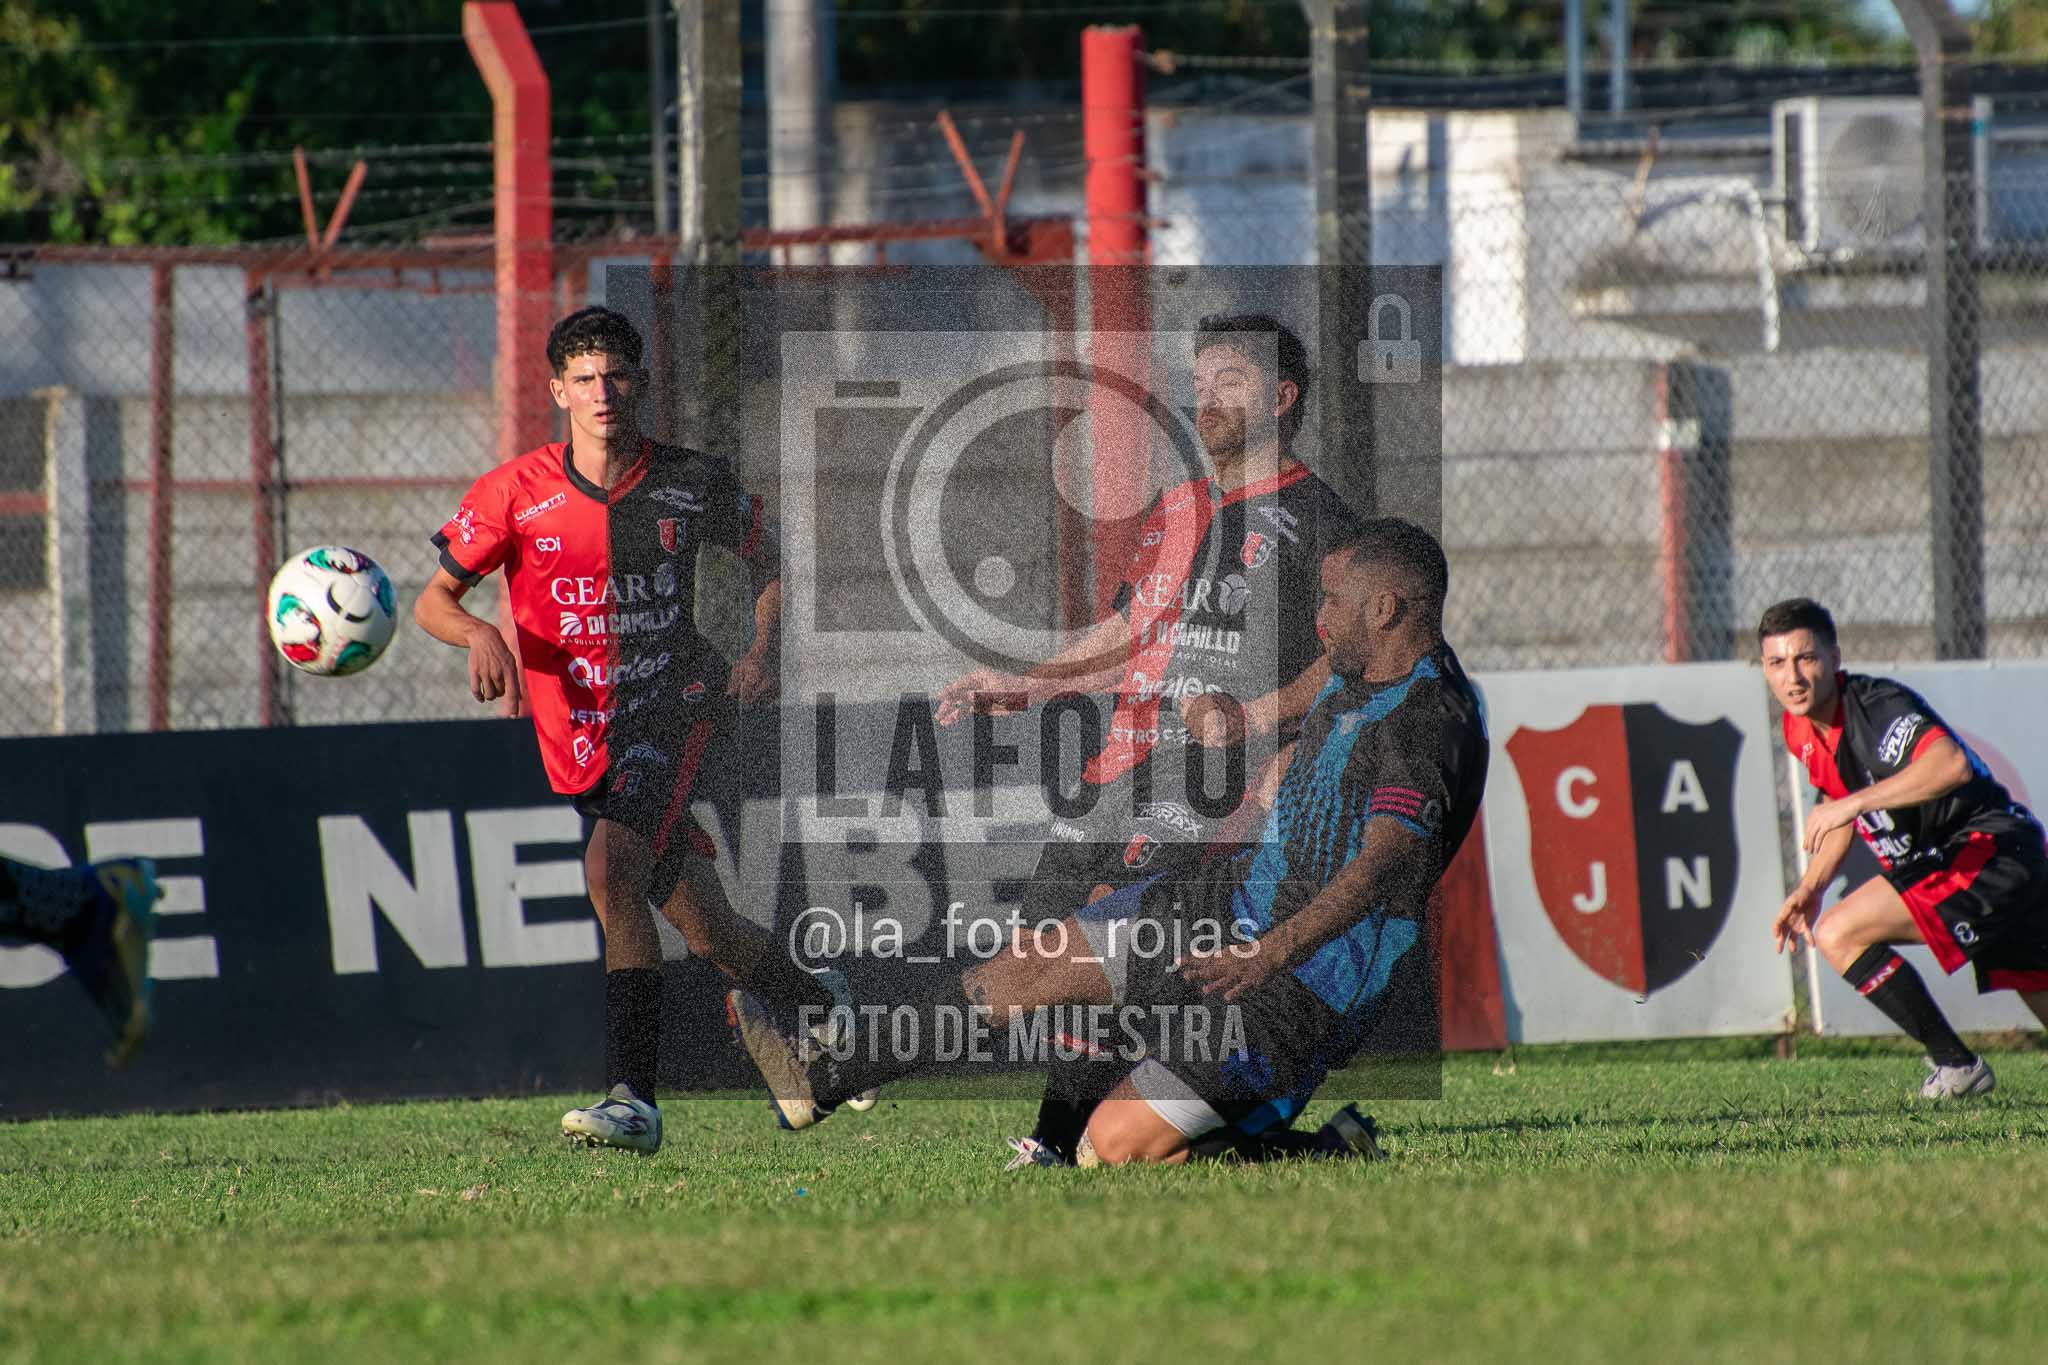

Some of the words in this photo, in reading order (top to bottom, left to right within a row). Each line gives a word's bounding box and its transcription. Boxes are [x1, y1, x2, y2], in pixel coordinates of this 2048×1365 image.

[550, 573, 652, 606] GEAR
[1555, 766, 1599, 819] C
[1661, 760, 1709, 813] A
[1573, 862, 1607, 915] J
[1666, 857, 1712, 910] N
